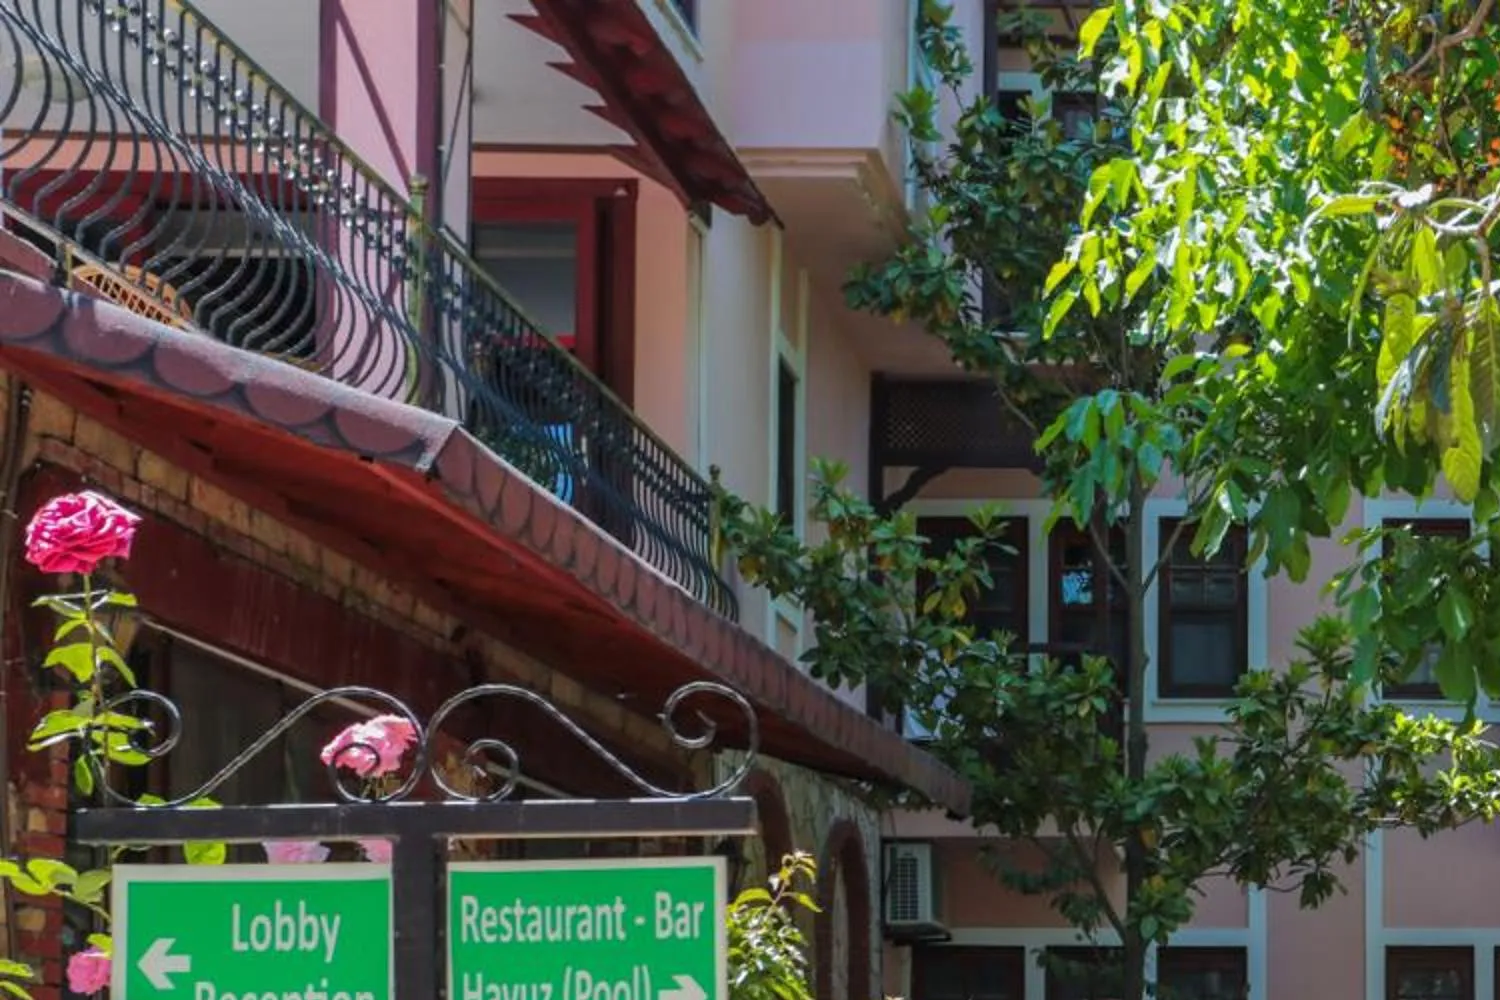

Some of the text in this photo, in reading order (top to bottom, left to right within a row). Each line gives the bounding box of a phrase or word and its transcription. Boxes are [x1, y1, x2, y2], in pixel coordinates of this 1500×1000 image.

[233, 901, 340, 961] Lobby
[462, 896, 625, 942] Restaurant
[656, 892, 704, 938] Bar
